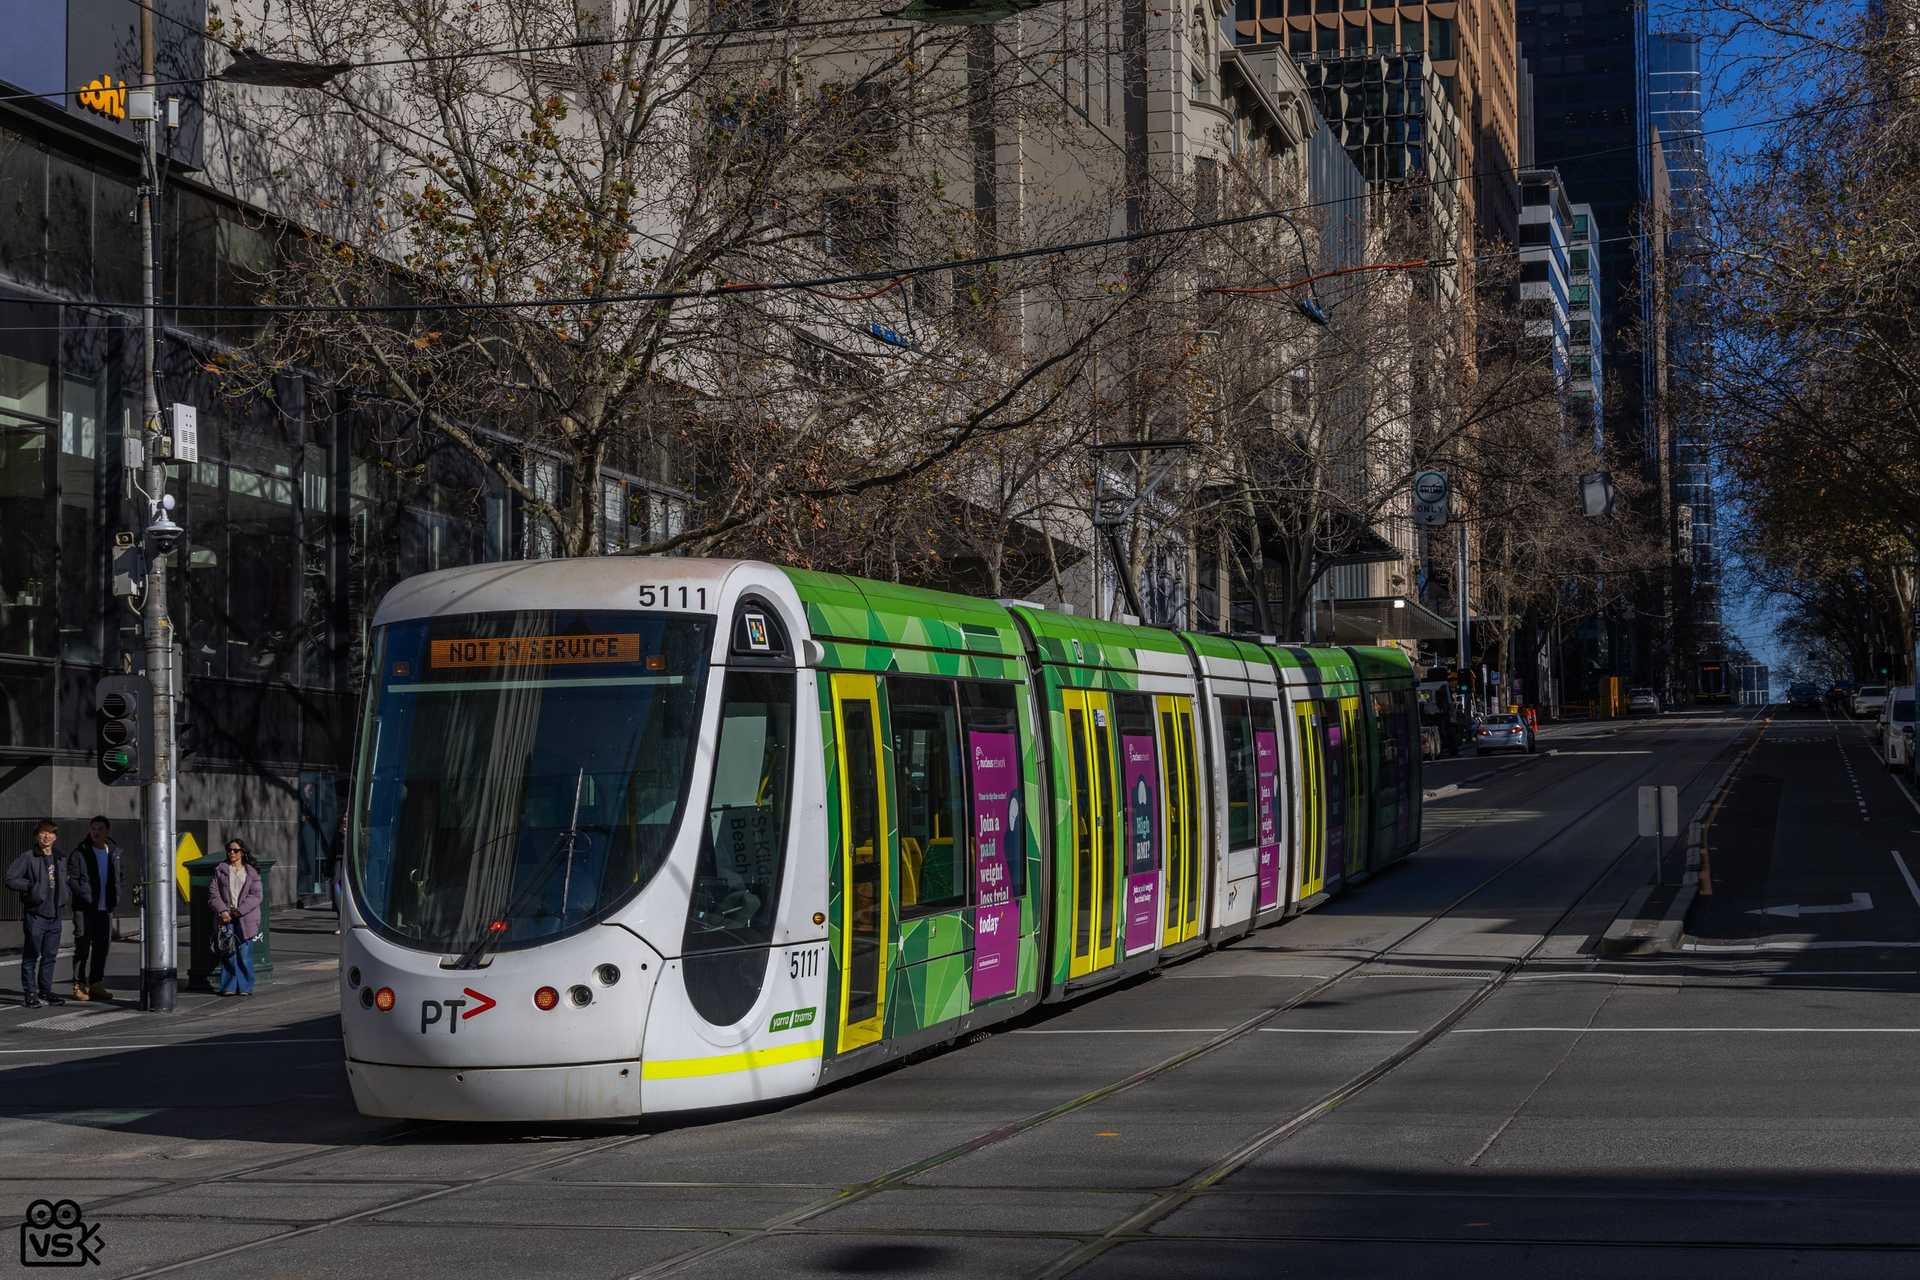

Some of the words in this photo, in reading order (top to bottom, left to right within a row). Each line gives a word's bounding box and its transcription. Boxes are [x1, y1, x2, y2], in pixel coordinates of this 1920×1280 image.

[1417, 504, 1443, 512] ONLY
[638, 585, 706, 610] 5111
[450, 642, 488, 662] NOT
[980, 813, 994, 837] Join
[731, 819, 751, 874] Beach
[980, 838, 996, 862] paid
[980, 863, 1003, 886] weight
[980, 890, 993, 905] loss
[994, 886, 1009, 902] trial
[979, 913, 1000, 936] today
[790, 949, 819, 979] 5111
